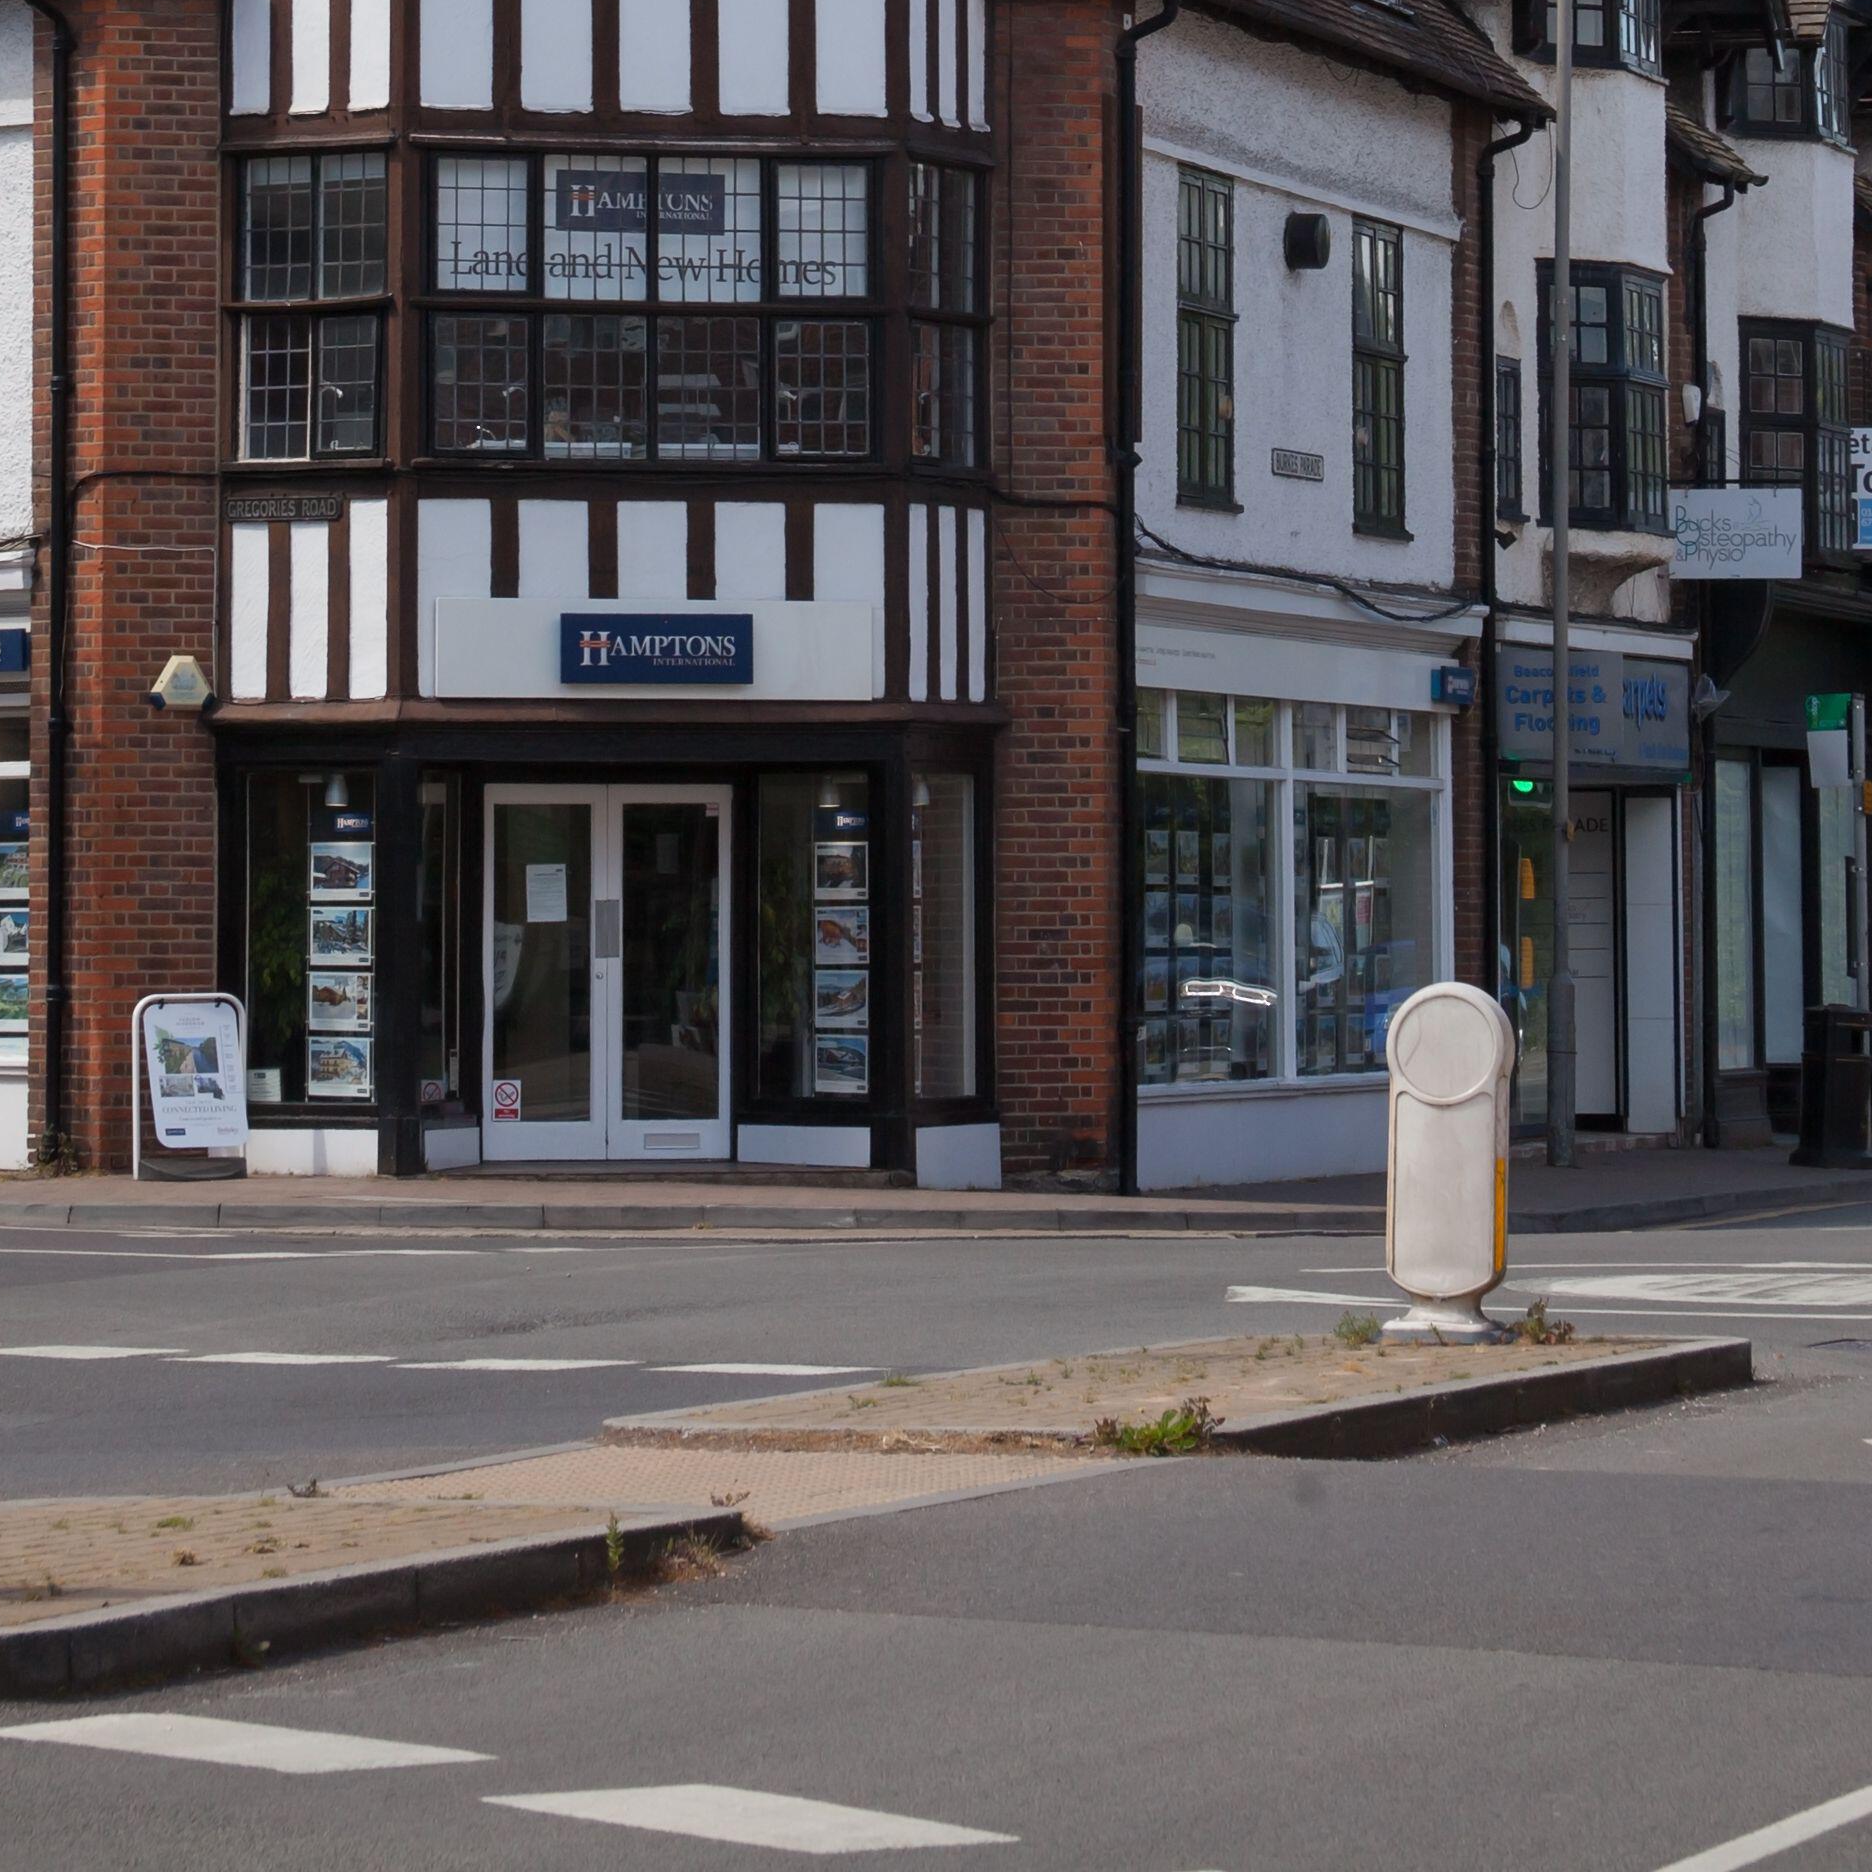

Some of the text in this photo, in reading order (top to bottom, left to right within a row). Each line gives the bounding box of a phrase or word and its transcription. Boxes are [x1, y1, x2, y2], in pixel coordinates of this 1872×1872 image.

[636, 210, 712, 221] INRNATIONAL
[549, 243, 613, 279] and
[228, 499, 336, 517] GREGORIES ROAD
[1676, 505, 1731, 533] Bucks
[1676, 521, 1797, 555] Osteopathy
[580, 631, 736, 666] HAMPTONS
[653, 658, 736, 667] INTERNATIONAL
[1514, 665, 1600, 678] Beacofield
[1505, 684, 1607, 708] Carpts &
[1623, 671, 1668, 732] arpets
[1514, 712, 1601, 736] Flooing
